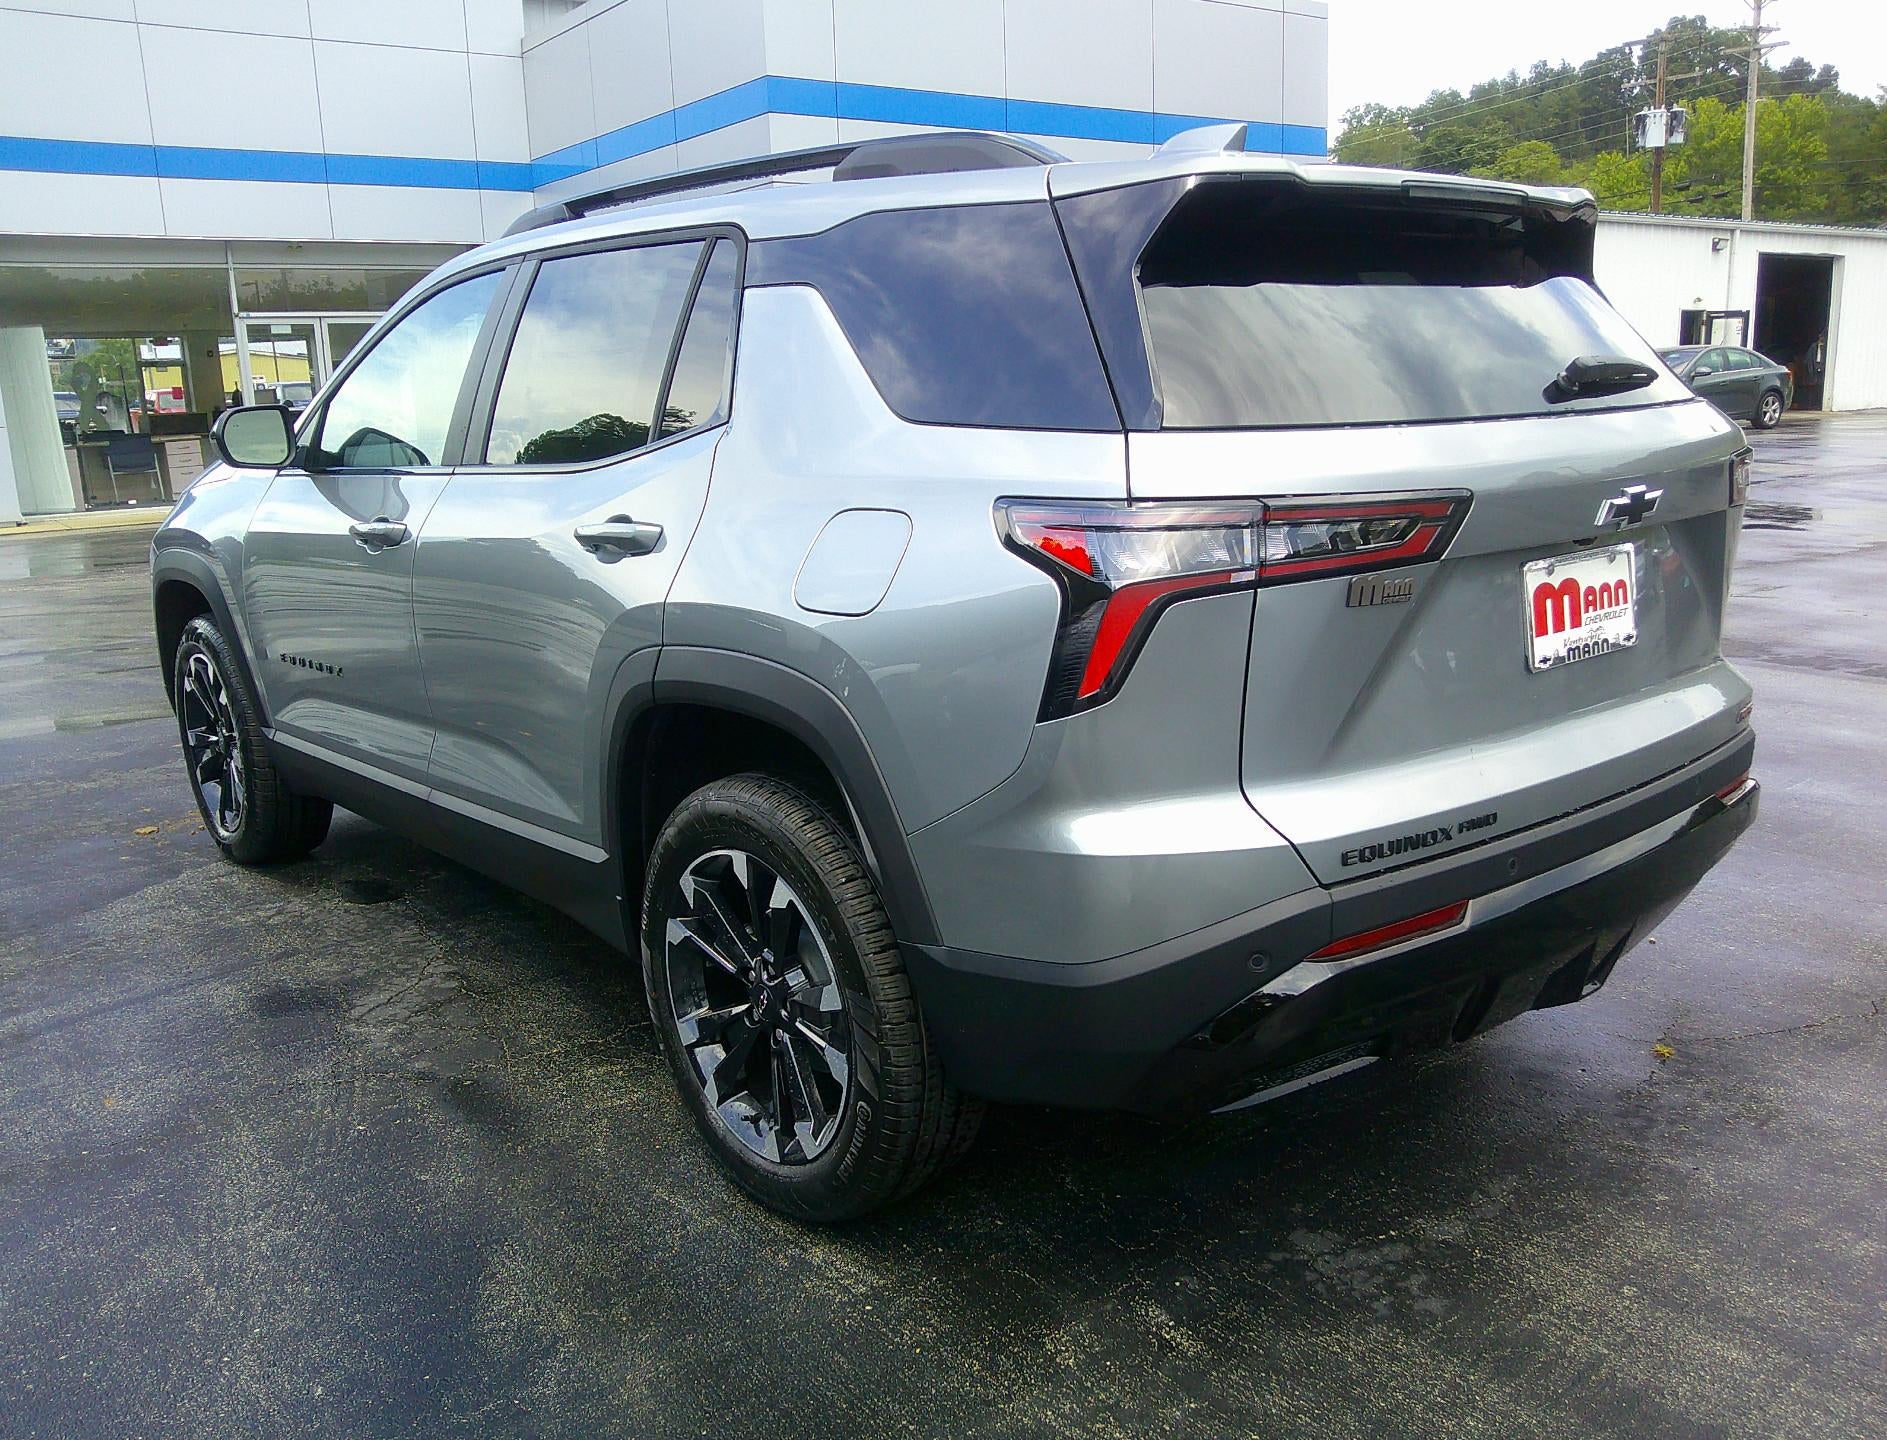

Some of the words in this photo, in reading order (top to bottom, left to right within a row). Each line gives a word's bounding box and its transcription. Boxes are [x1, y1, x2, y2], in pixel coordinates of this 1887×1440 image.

[1584, 607, 1629, 626] CHEVROLET
[1566, 637, 1610, 662] MANN
[1340, 824, 1454, 867] EQUINOX
[1457, 811, 1498, 834] AWD
